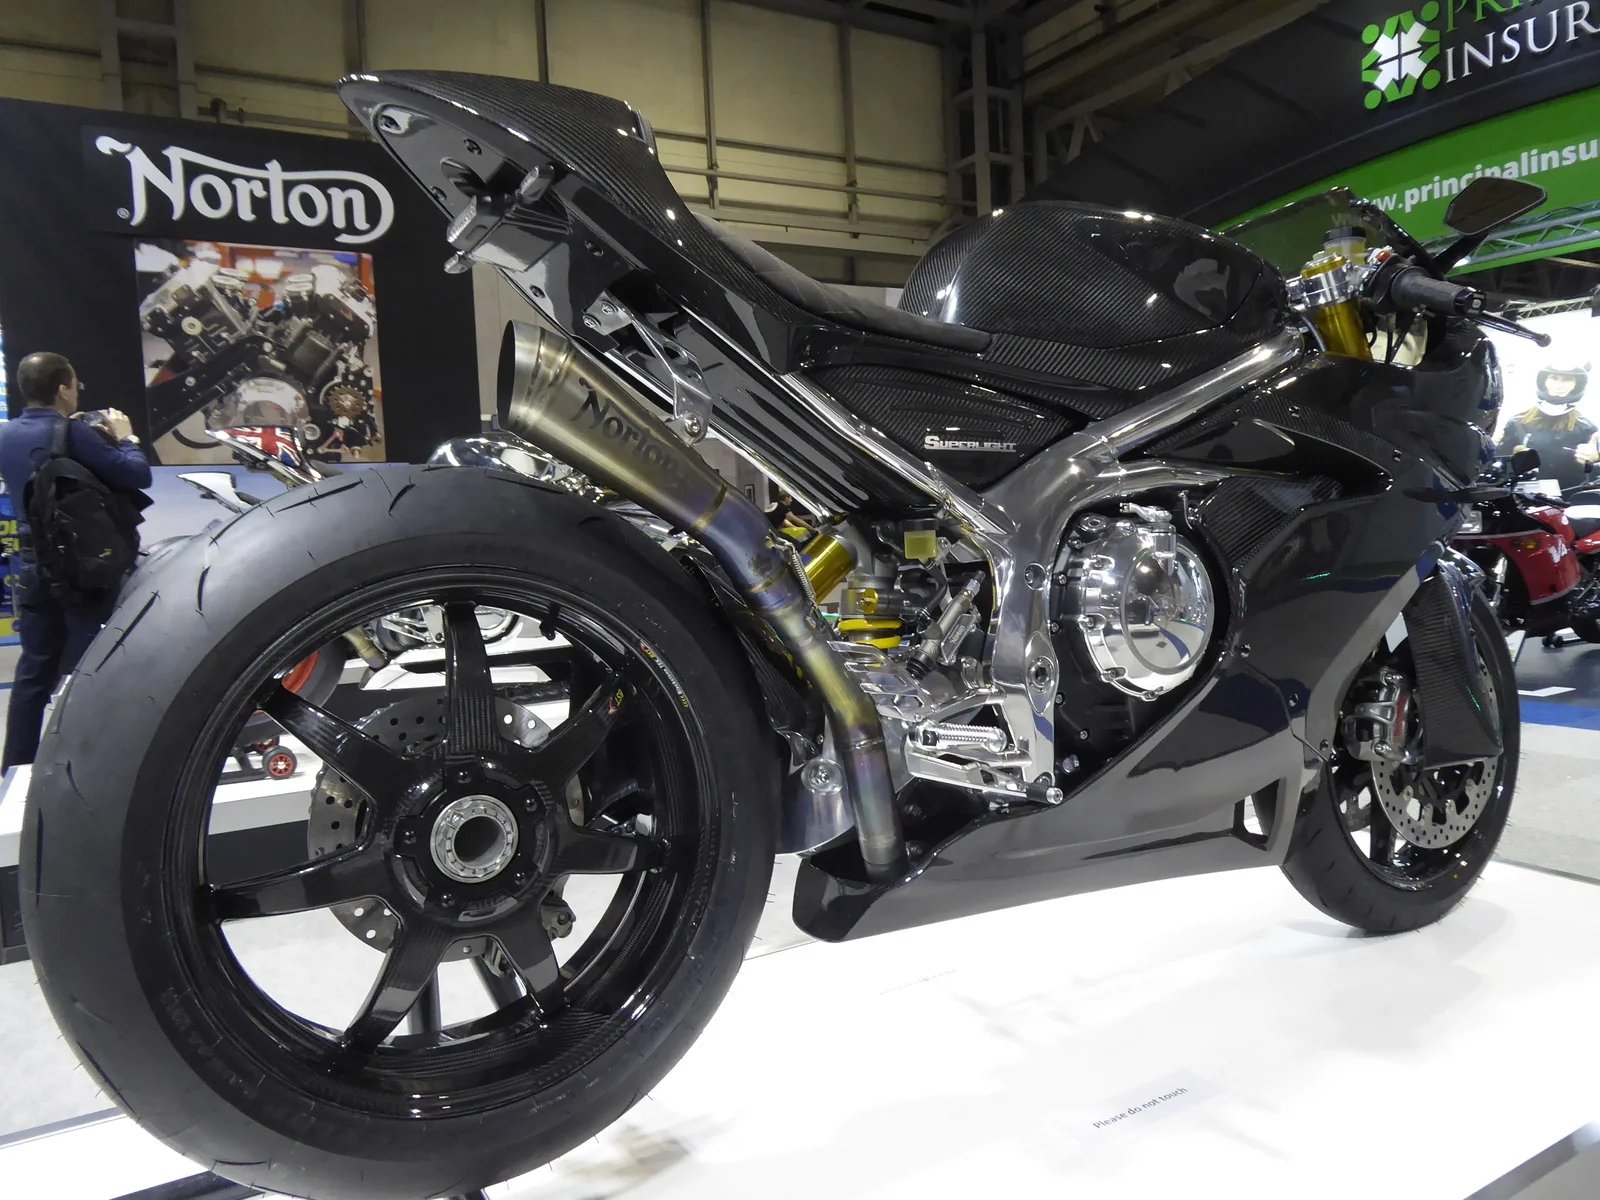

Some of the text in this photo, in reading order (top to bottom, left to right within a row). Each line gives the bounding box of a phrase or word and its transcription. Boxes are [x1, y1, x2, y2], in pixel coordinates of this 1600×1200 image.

[1445, 0, 1600, 83] INSUR
[95, 135, 395, 244] Norton
[570, 377, 680, 471] Norton
[1092, 1087, 1188, 1130] Please do not touch
